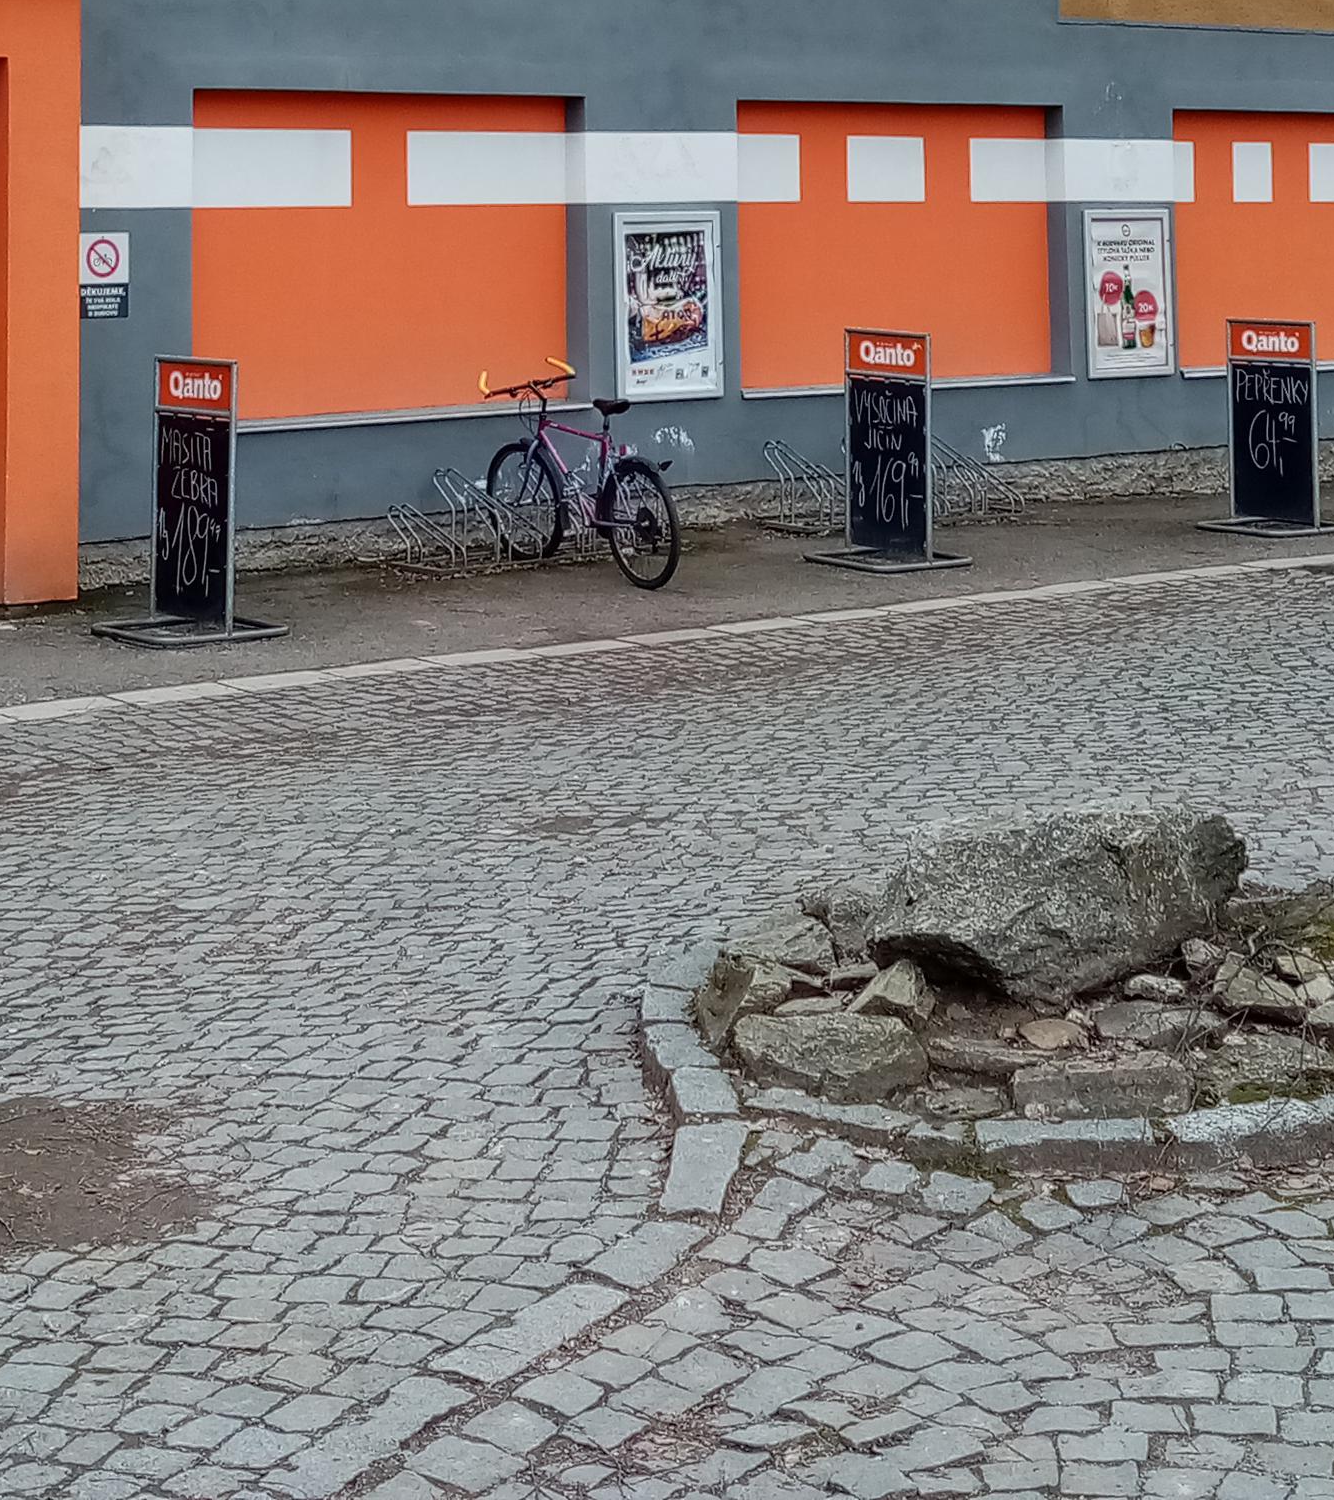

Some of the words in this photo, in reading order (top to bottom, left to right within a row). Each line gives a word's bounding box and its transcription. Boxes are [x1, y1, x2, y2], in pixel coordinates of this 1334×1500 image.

[859, 339, 915, 367] Qanto
[1241, 329, 1300, 353] Qanto
[169, 370, 222, 400] Qanto
[1236, 368, 1309, 405] PEPŘENKY
[854, 389, 918, 427] VYSOČINA
[864, 425, 903, 451] JIČÍN
